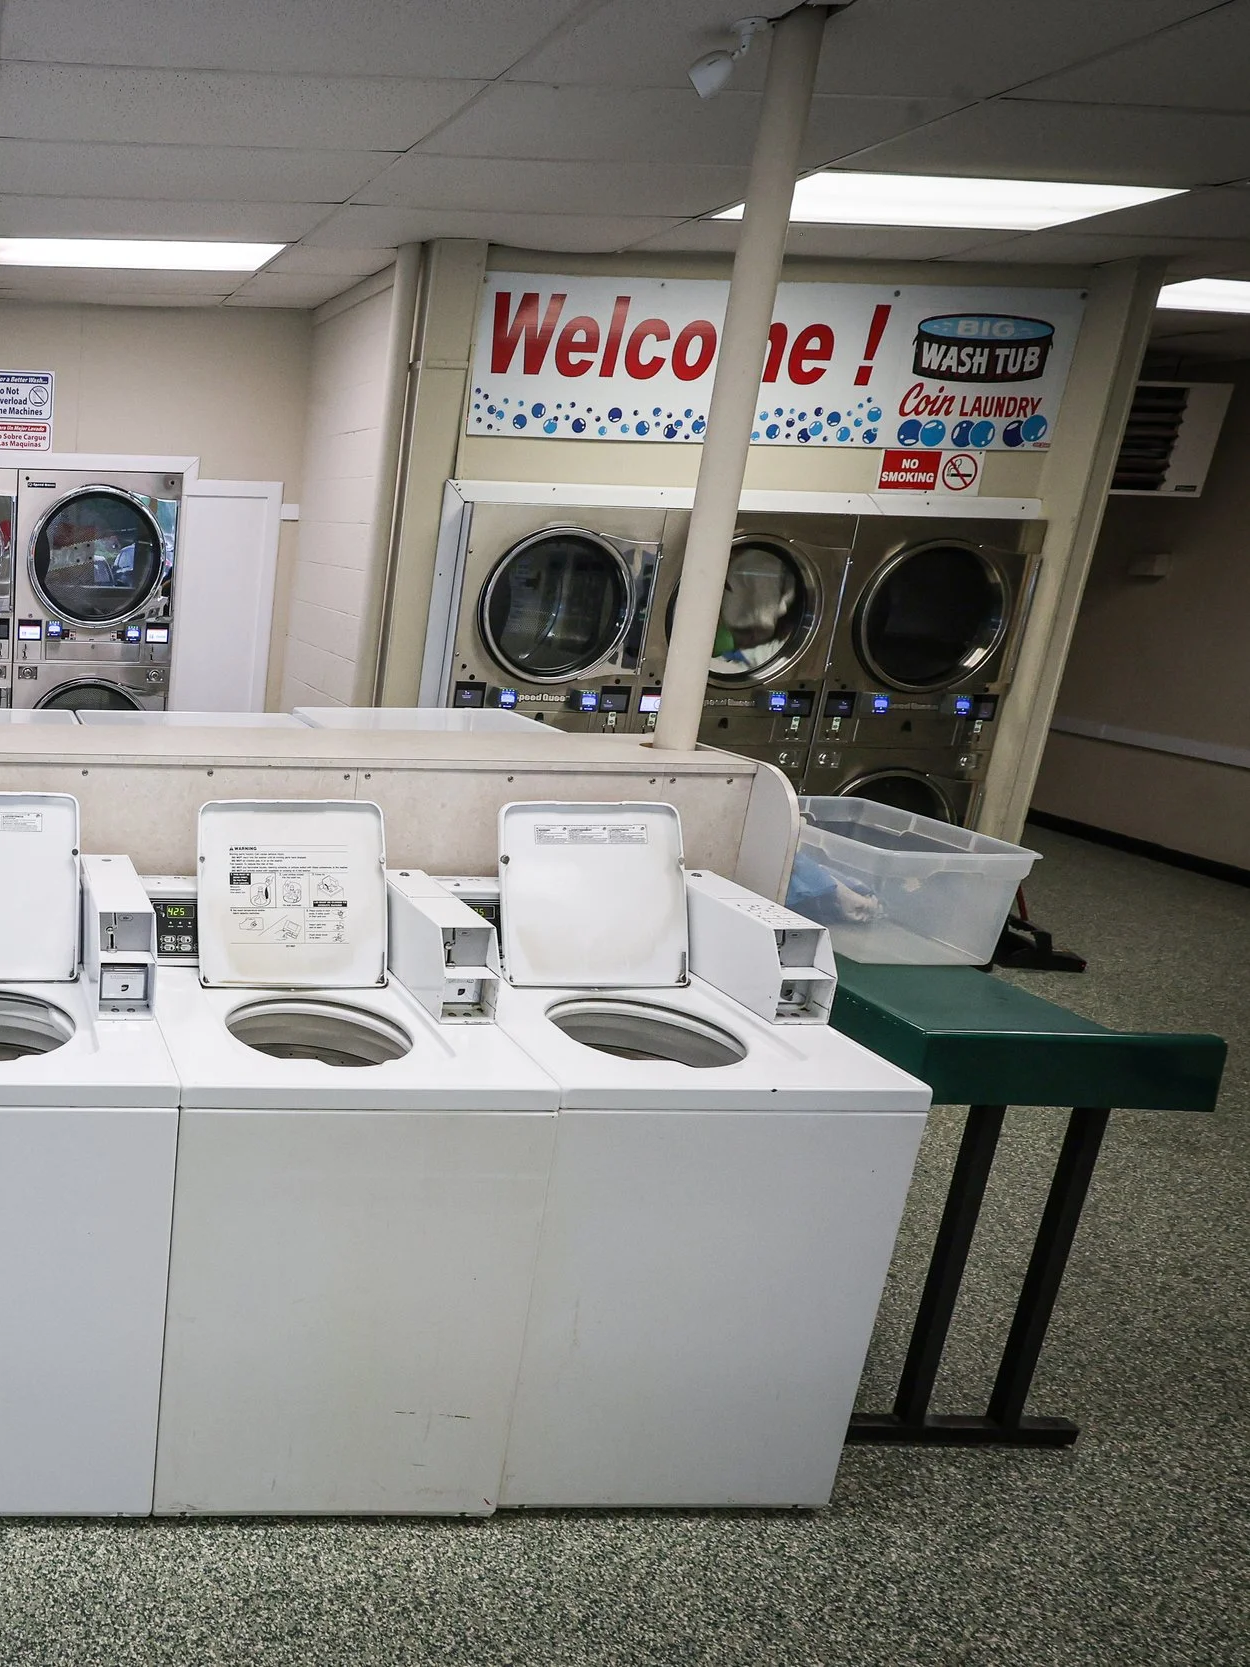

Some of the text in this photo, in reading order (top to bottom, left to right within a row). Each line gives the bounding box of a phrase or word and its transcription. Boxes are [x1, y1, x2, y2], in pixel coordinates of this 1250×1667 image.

[957, 320, 1015, 336] BIG
[854, 304, 892, 386] !
[922, 342, 1040, 374] WASH TUB
[6, 387, 19, 395] Not
[899, 382, 1042, 418] Coin LAUNDRY
[9, 407, 43, 415] Machines
[10, 440, 41, 448] Maquinas
[901, 458, 919, 469] NO
[881, 471, 935, 483] SMOKING
